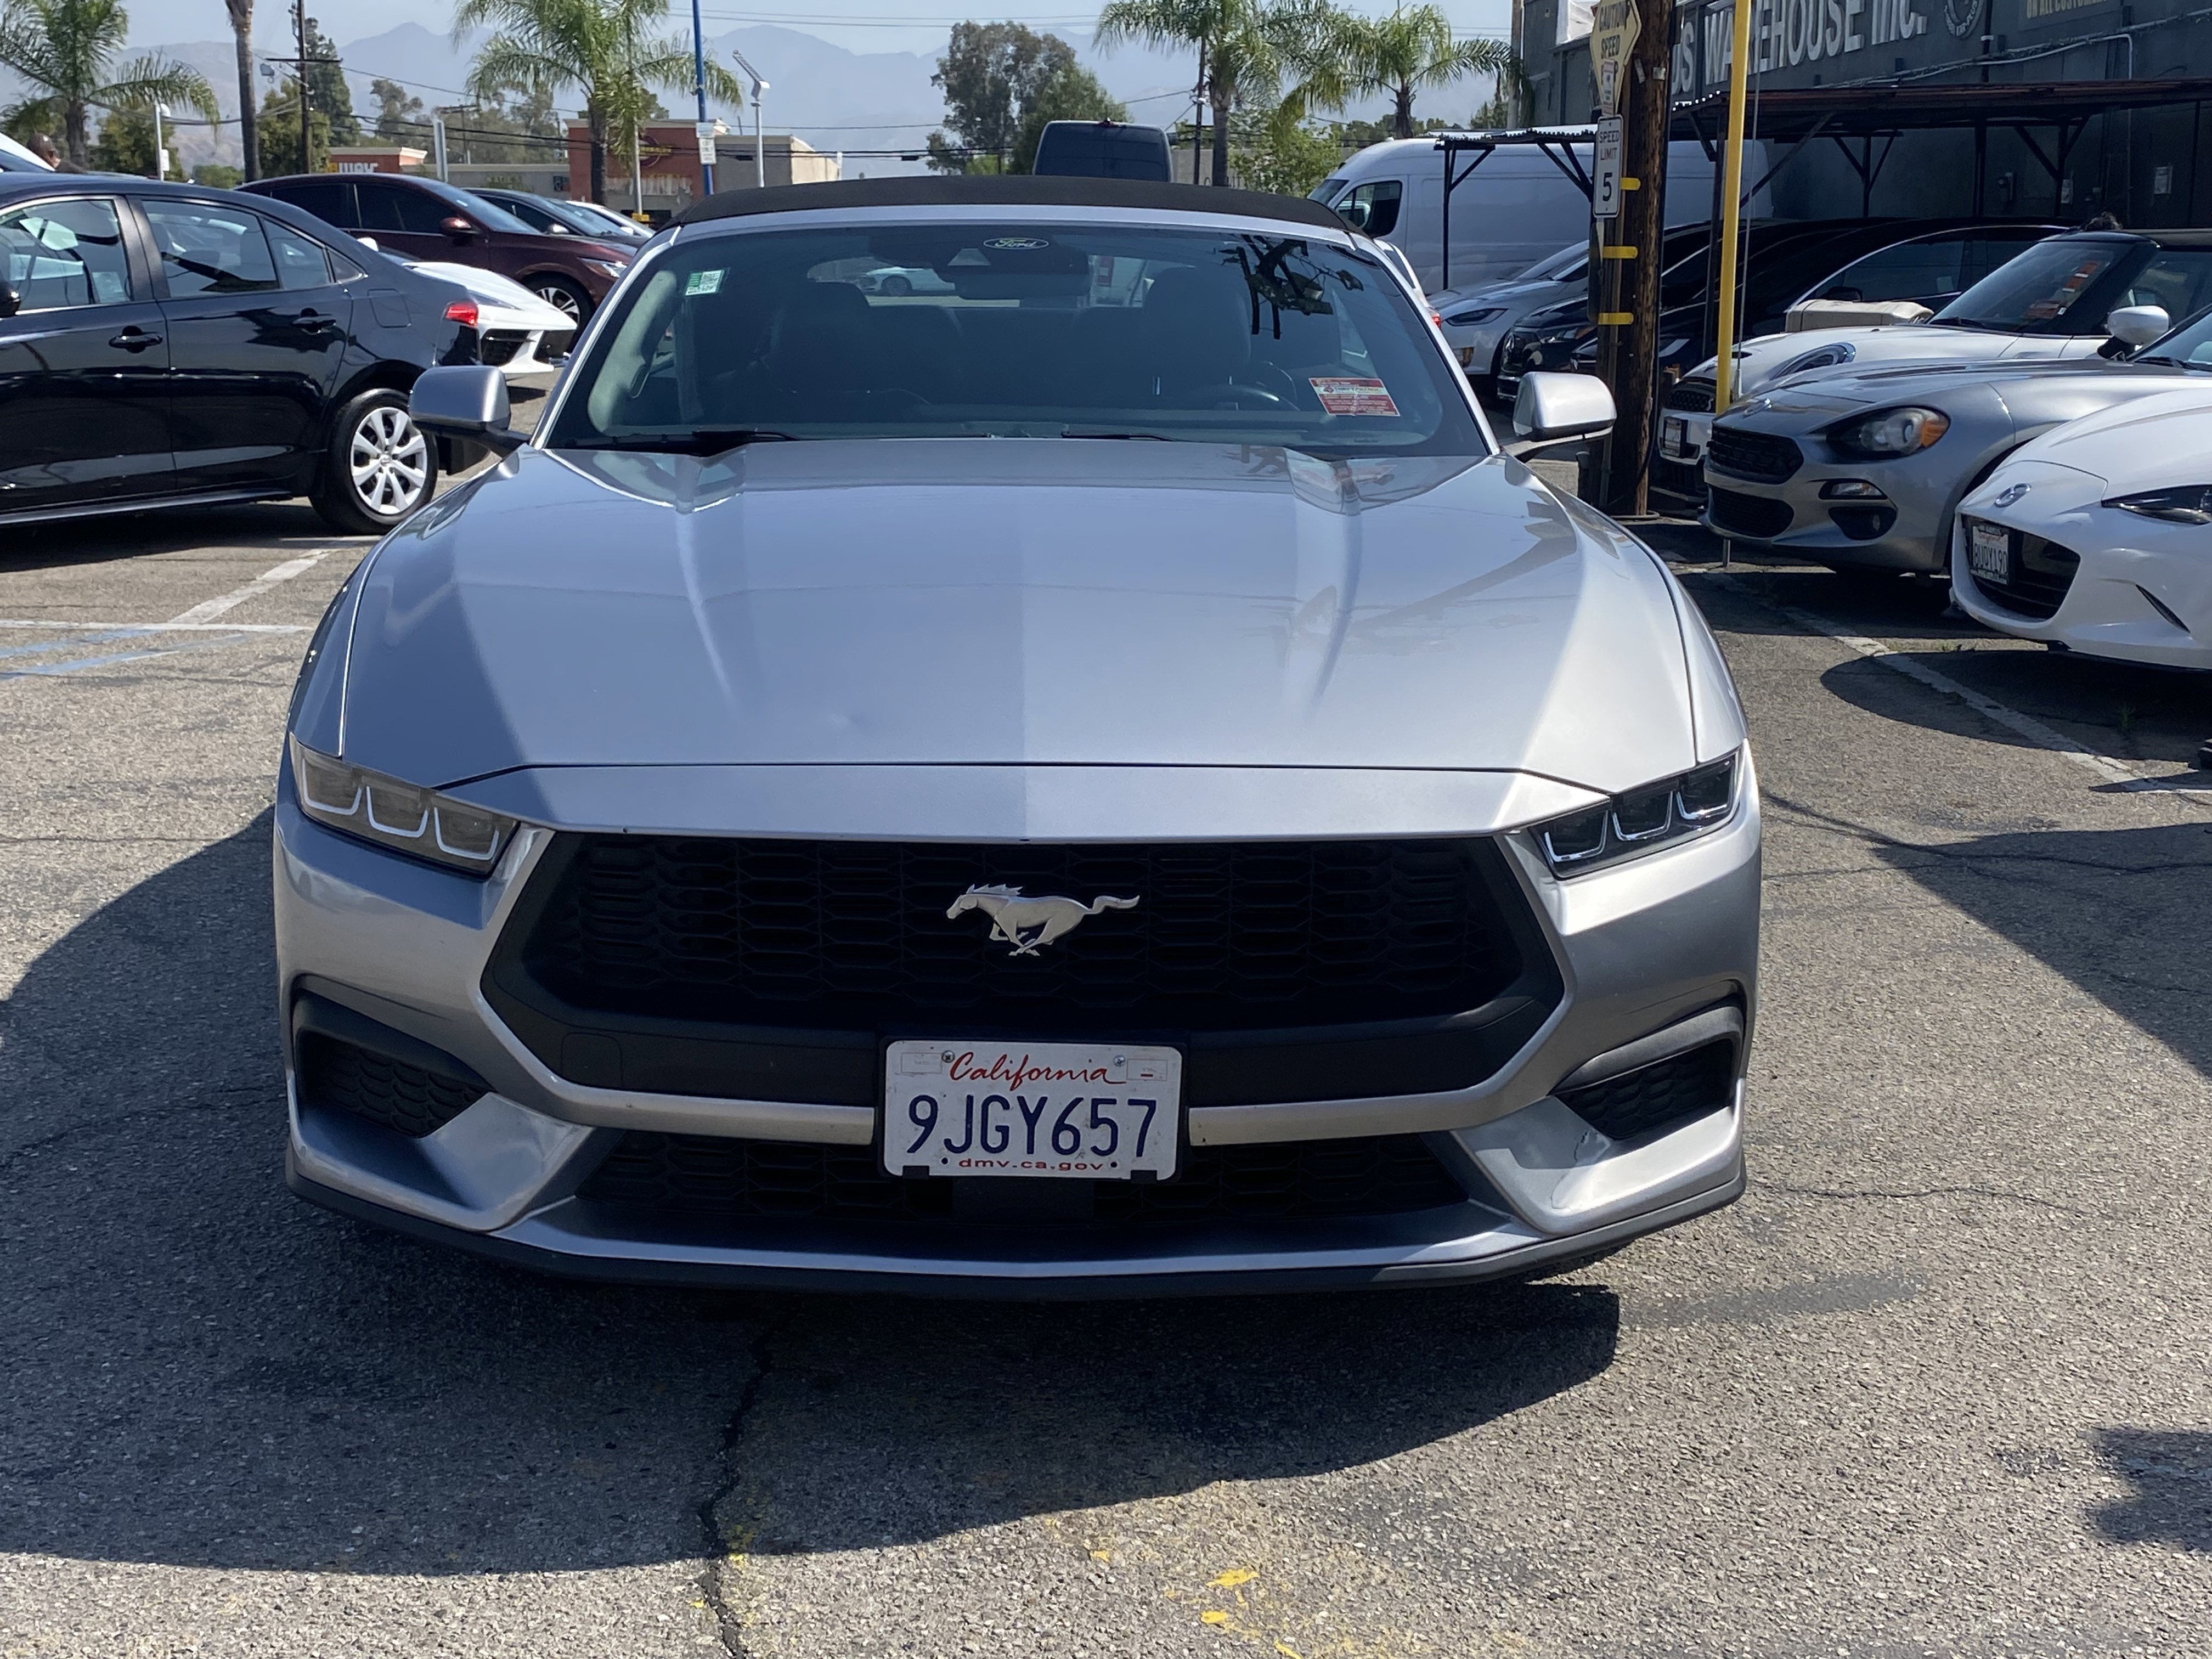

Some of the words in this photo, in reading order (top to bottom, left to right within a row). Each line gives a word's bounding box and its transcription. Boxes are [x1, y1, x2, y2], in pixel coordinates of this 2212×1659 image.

[1601, 35, 1620, 59] SPEED
[1705, 0, 1864, 85] WAEHOUSE
[1599, 130, 1619, 143] SPEED
[1600, 147, 1617, 160] LIMIT
[1602, 172, 1613, 201] 5
[994, 239, 1037, 247] Ford
[950, 1051, 1127, 1091] California
[906, 1094, 1157, 1158] 9JGY657
[958, 1158, 1103, 1171] dmv.ca.gov
